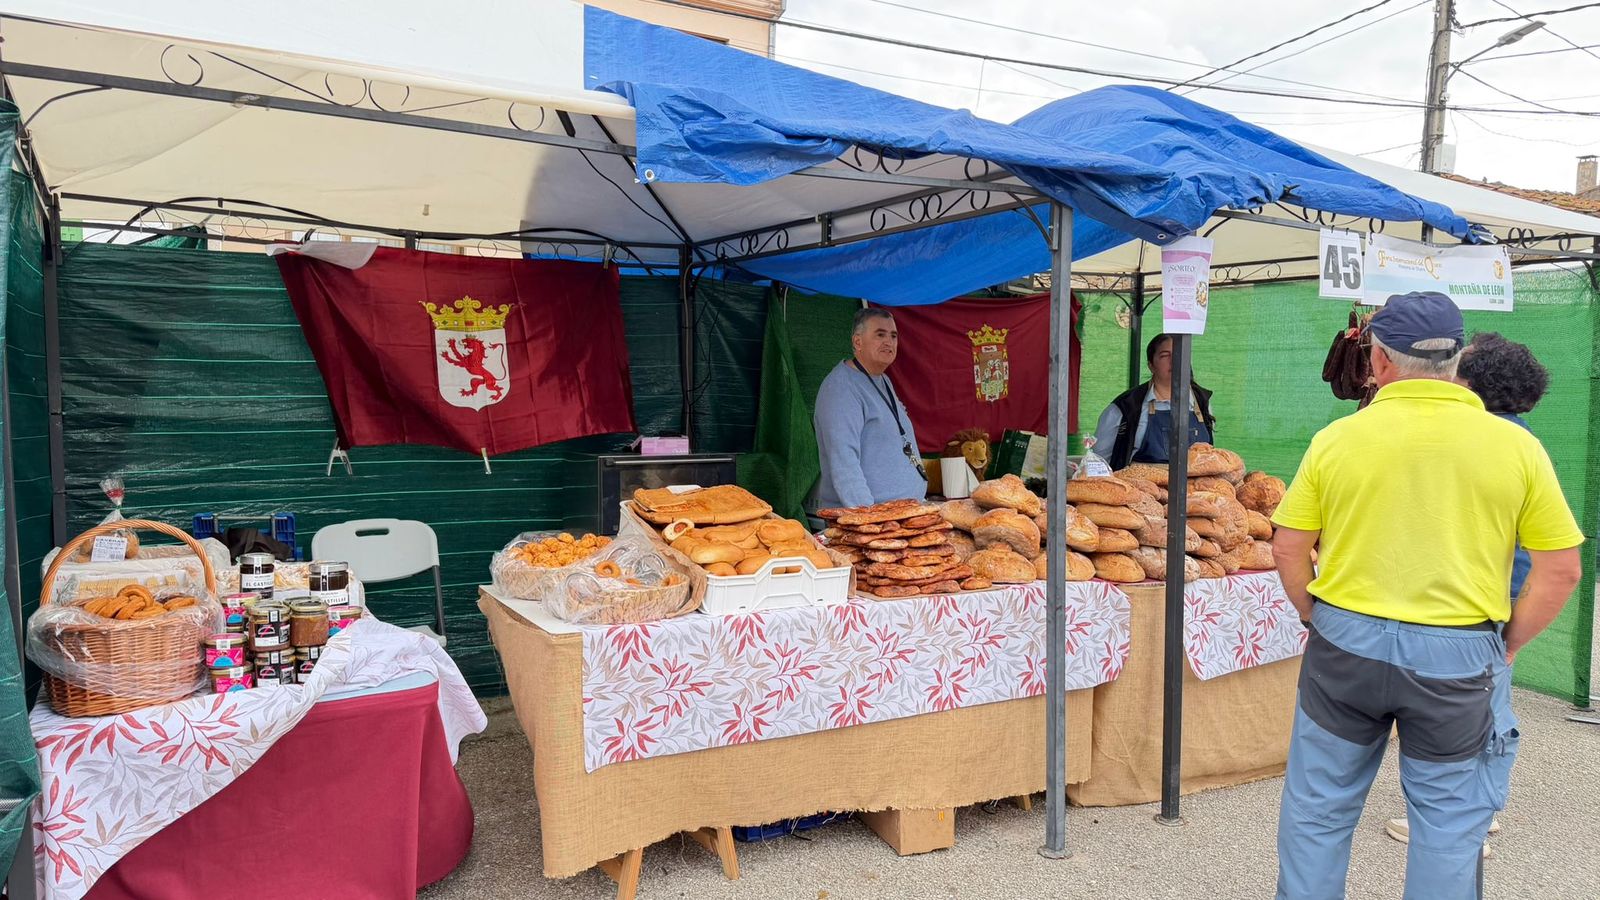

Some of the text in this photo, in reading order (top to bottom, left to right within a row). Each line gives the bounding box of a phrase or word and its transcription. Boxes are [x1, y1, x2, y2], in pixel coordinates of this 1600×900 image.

[1323, 244, 1361, 290] 45
[1448, 282, 1482, 295] MONTAÑA
[1482, 285, 1491, 295] DE
